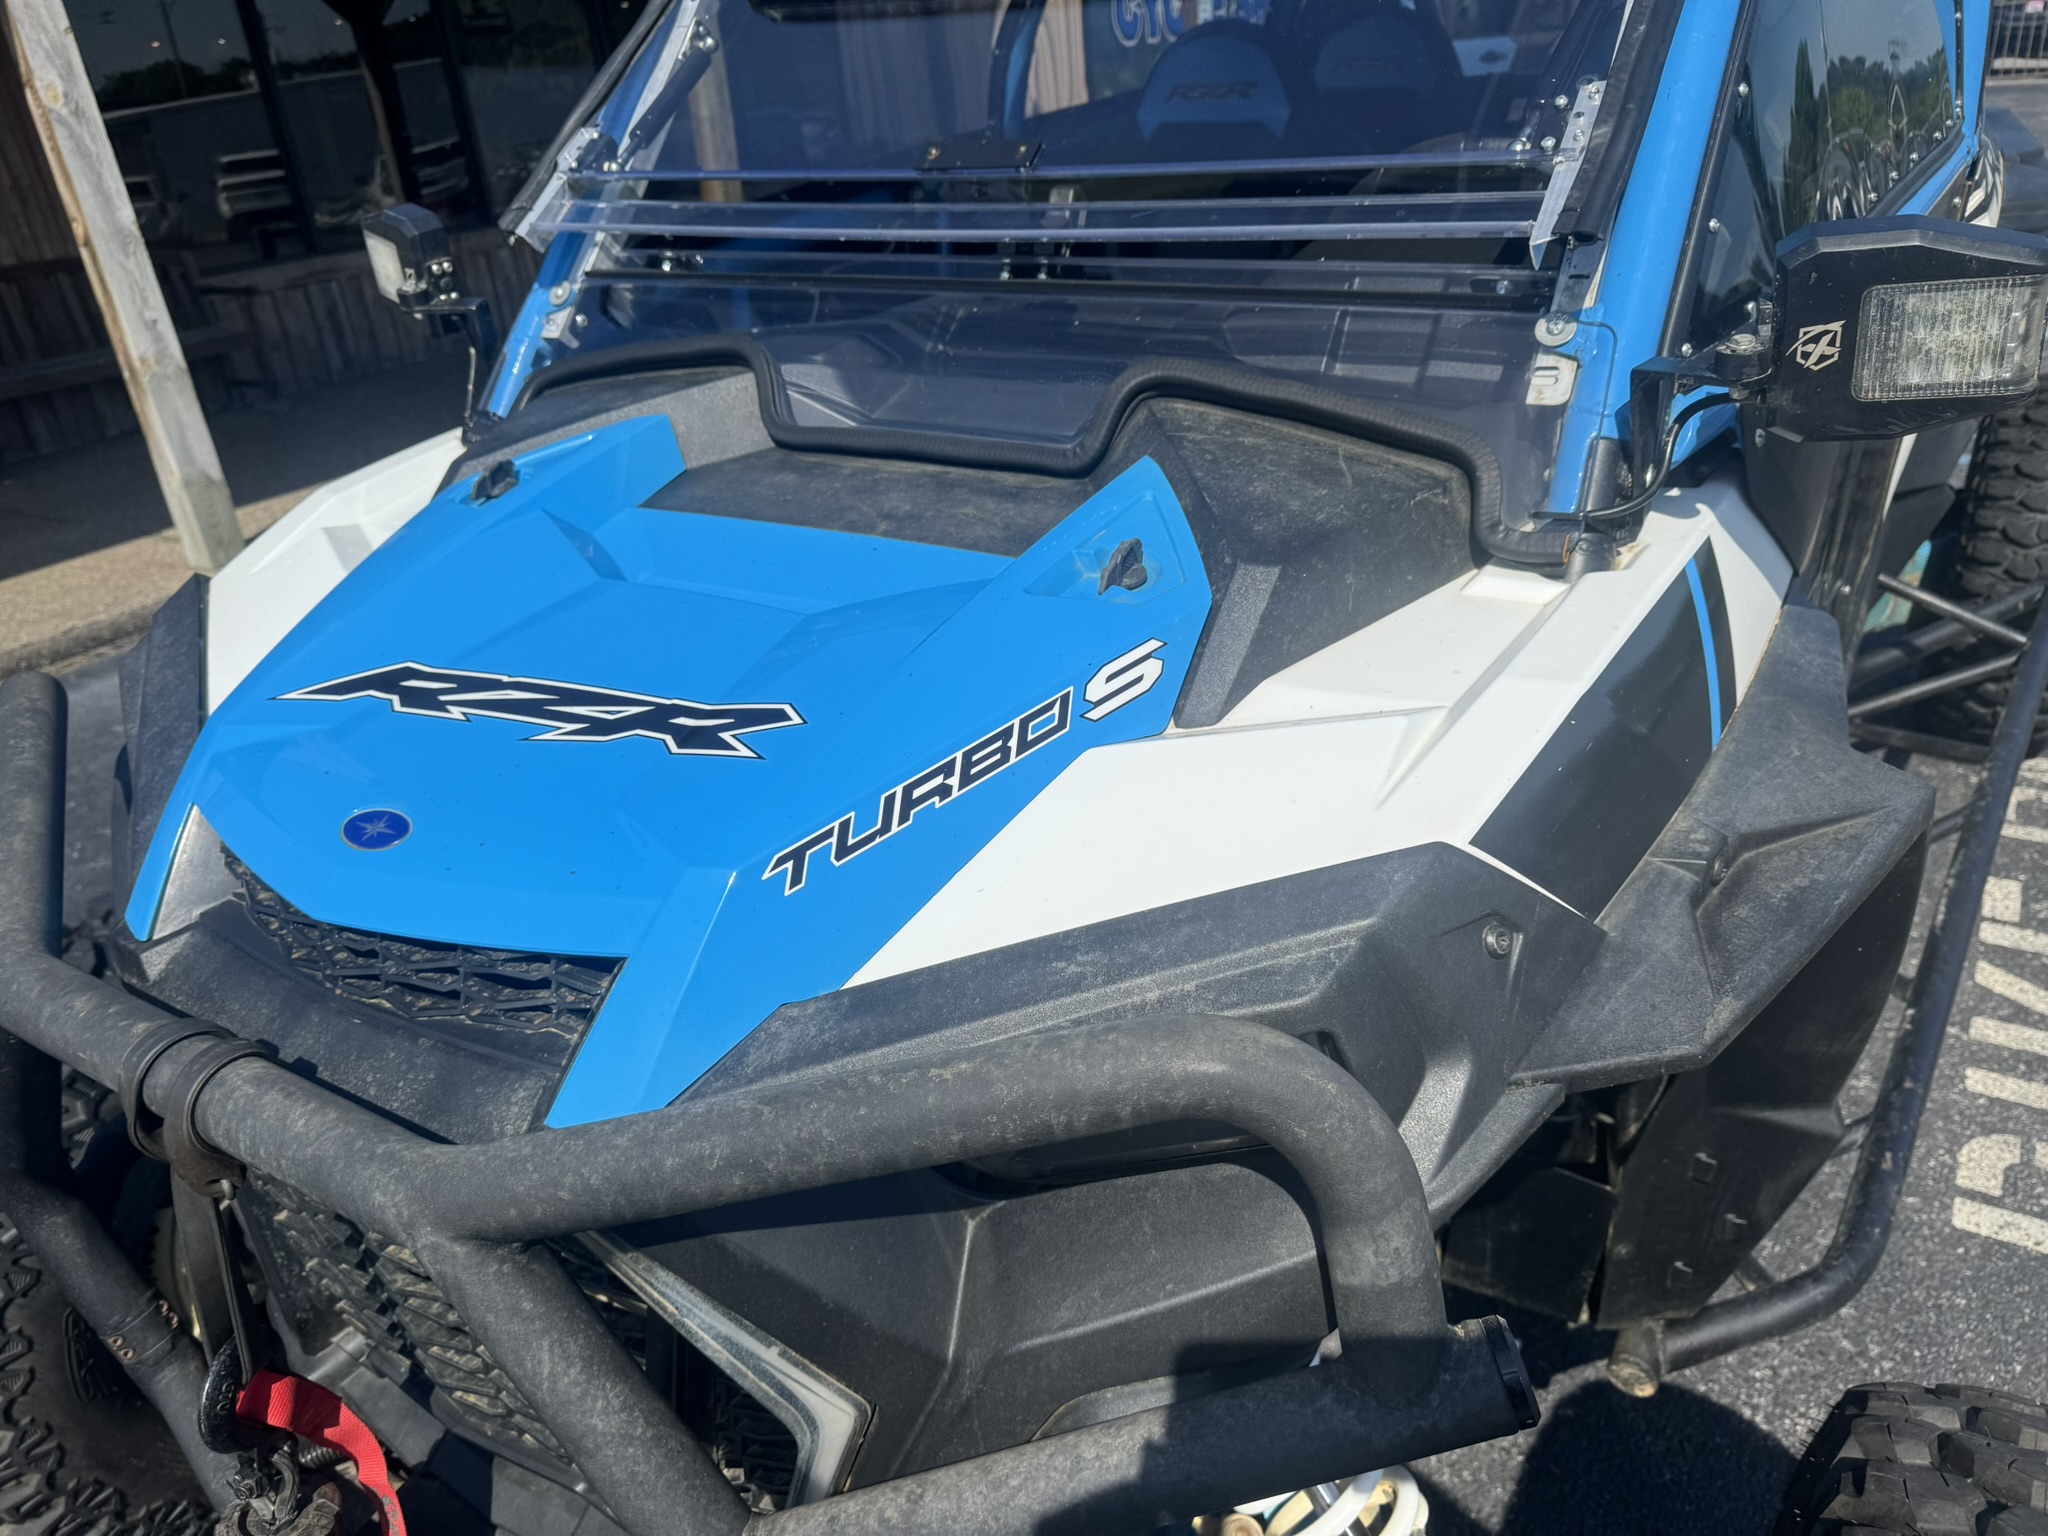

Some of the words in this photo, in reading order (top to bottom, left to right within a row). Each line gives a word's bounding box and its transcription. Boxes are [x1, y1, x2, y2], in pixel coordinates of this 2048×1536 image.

[270, 661, 808, 760] RZR
[761, 685, 1074, 896] TURBO
[1079, 636, 1168, 723] S
